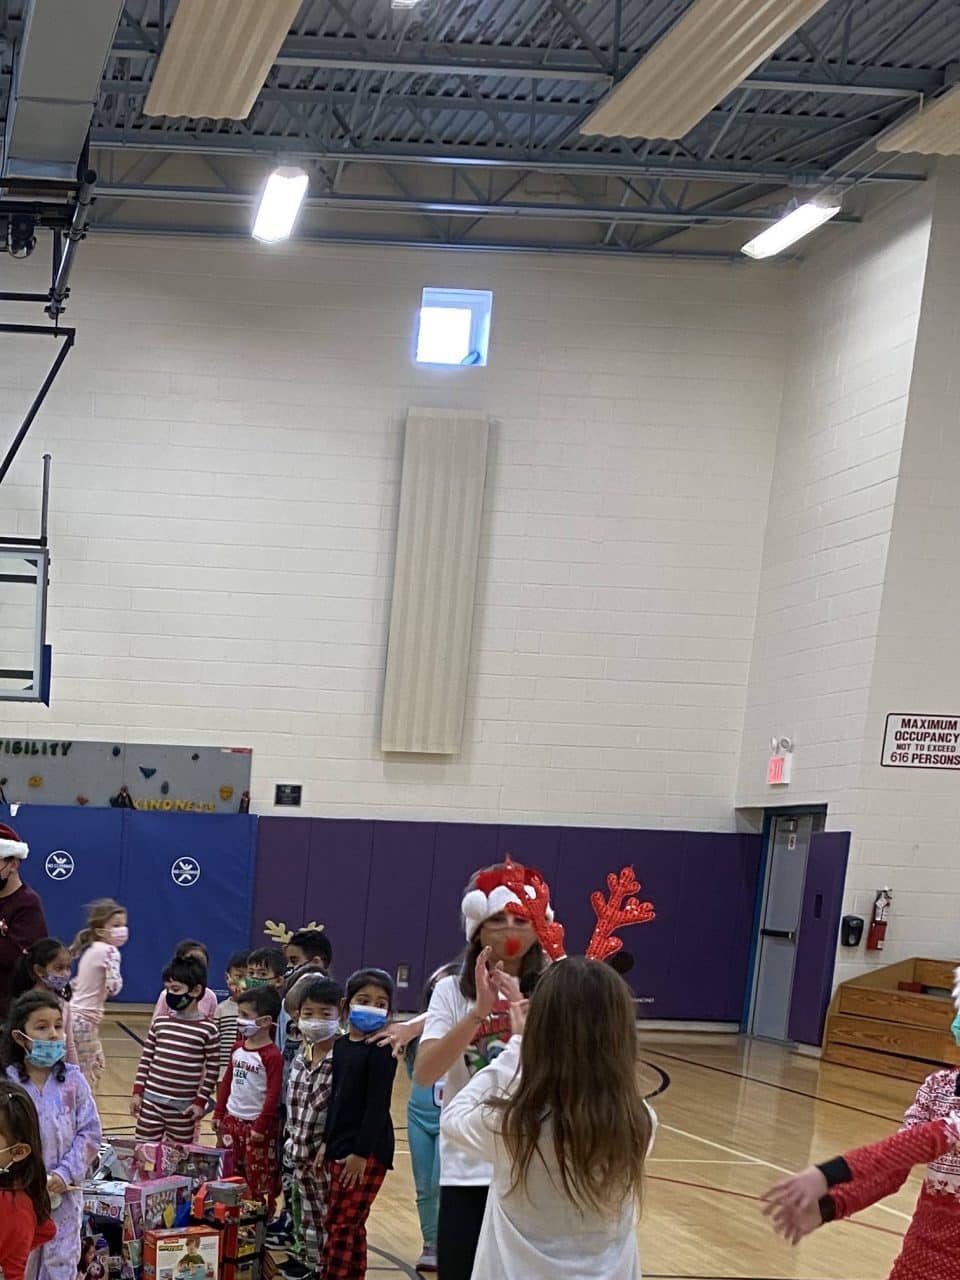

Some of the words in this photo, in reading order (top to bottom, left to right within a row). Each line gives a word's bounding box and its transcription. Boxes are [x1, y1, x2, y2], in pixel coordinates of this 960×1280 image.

[901, 718, 958, 730] MAXIMUM
[894, 730, 960, 743] OCCUPANCY
[927, 744, 956, 752] EXCEED
[890, 751, 909, 762] 616
[911, 753, 960, 765] PERSONS
